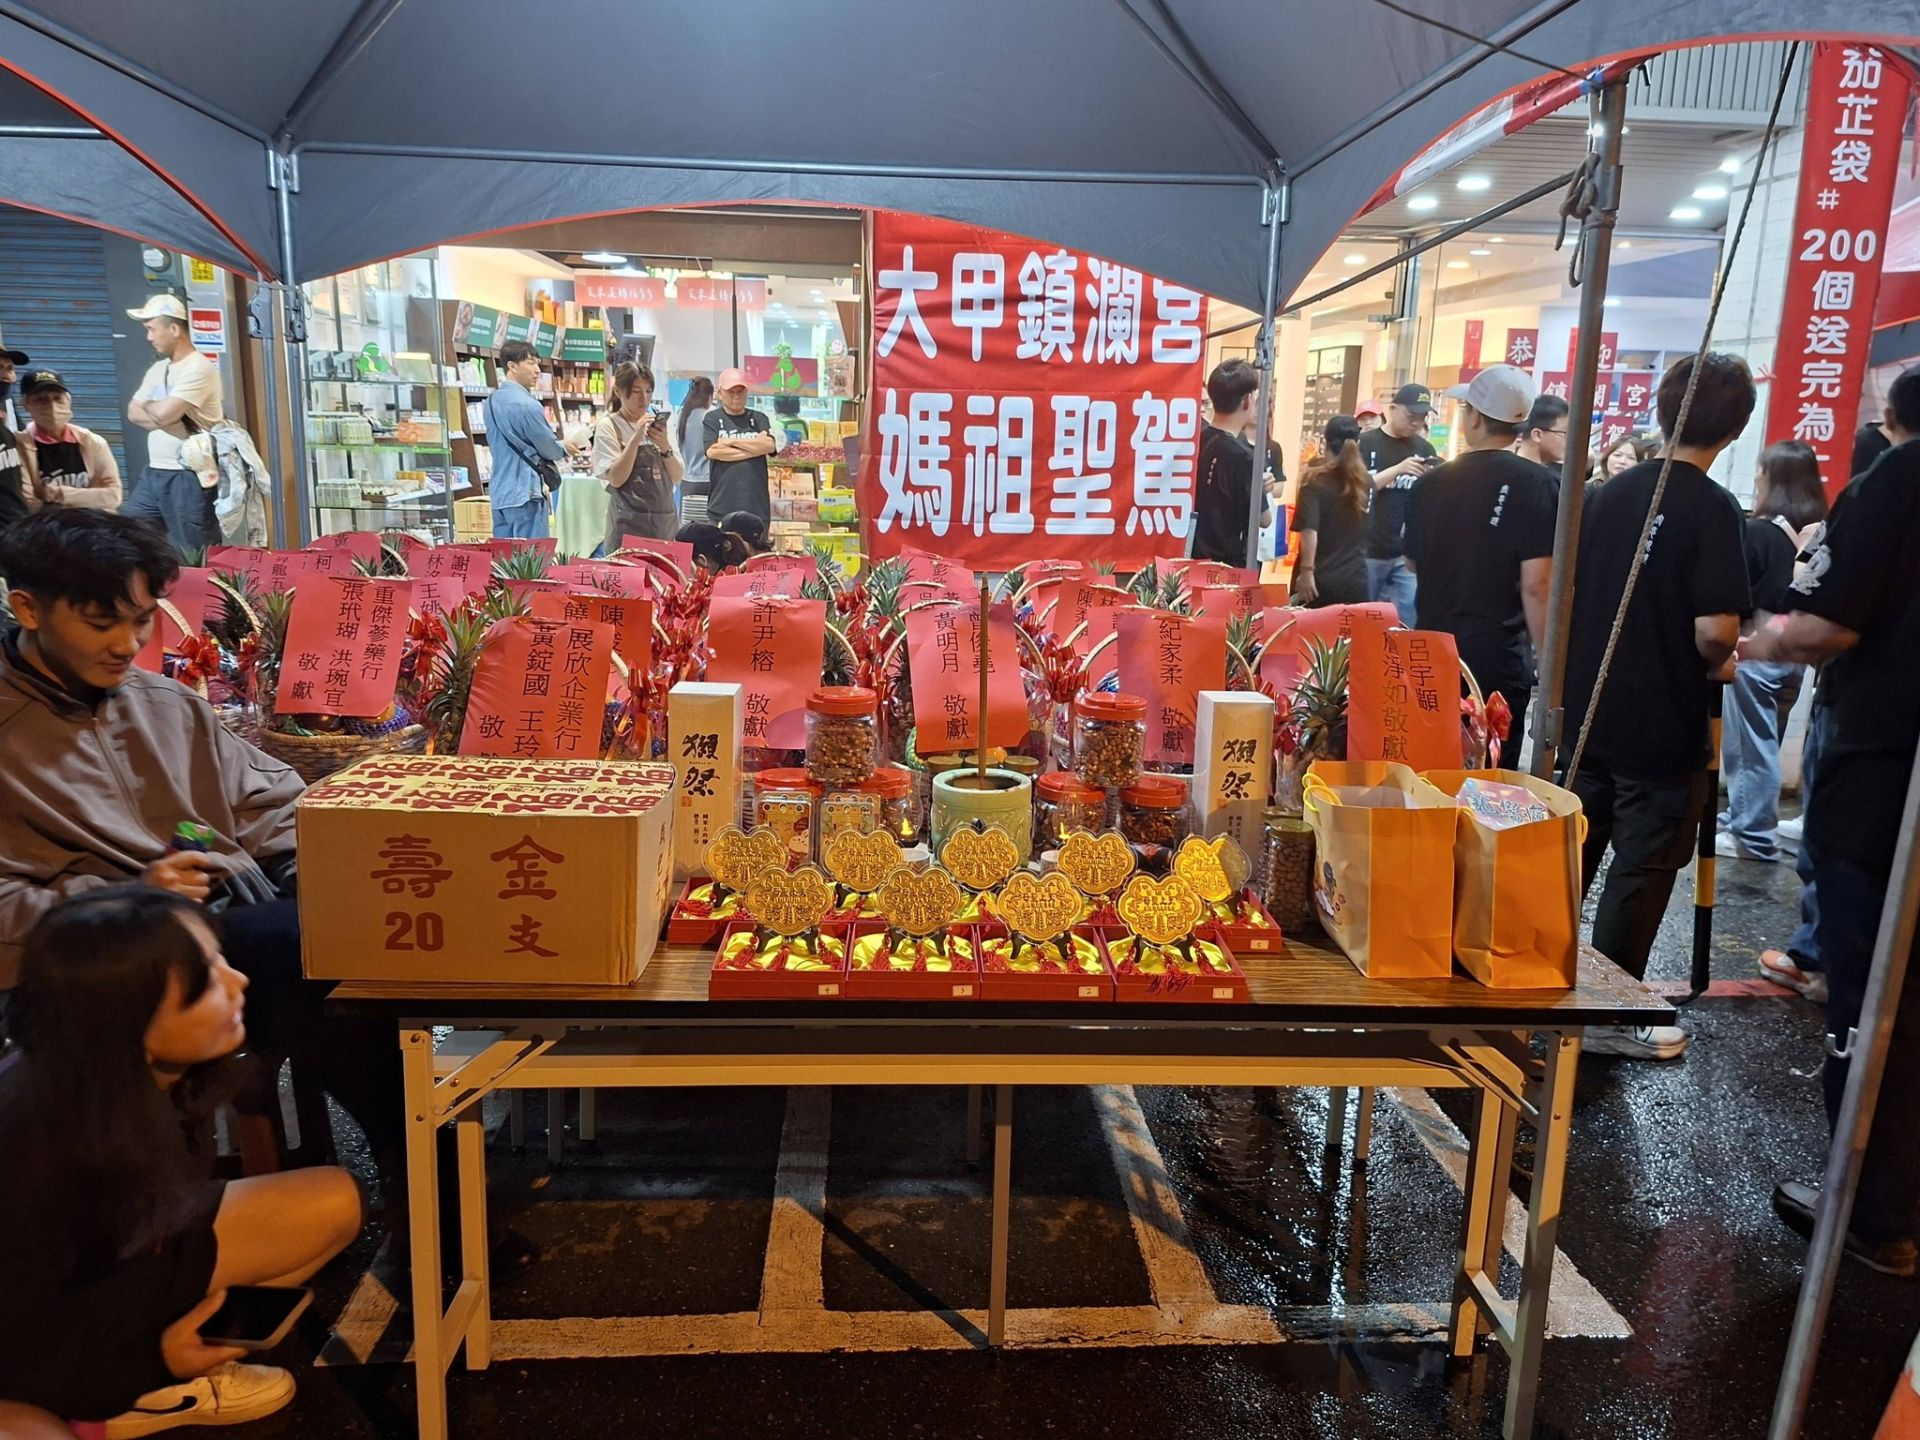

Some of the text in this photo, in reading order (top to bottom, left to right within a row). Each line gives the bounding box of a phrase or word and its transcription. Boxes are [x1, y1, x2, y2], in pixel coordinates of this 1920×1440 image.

[878, 245, 1206, 364] 大甲鎮瀾宮
[1508, 336, 1535, 364] 恭
[878, 388, 1197, 538] 媽祖聖駕
[523, 625, 557, 697] 黃錠國
[554, 628, 594, 751] 展欣企業行
[743, 602, 778, 738] 許尹榕 敬獻
[934, 611, 960, 674] 黃明月
[1159, 620, 1185, 753] 紀家柔 敬獻
[943, 694, 970, 740] 敬獻
